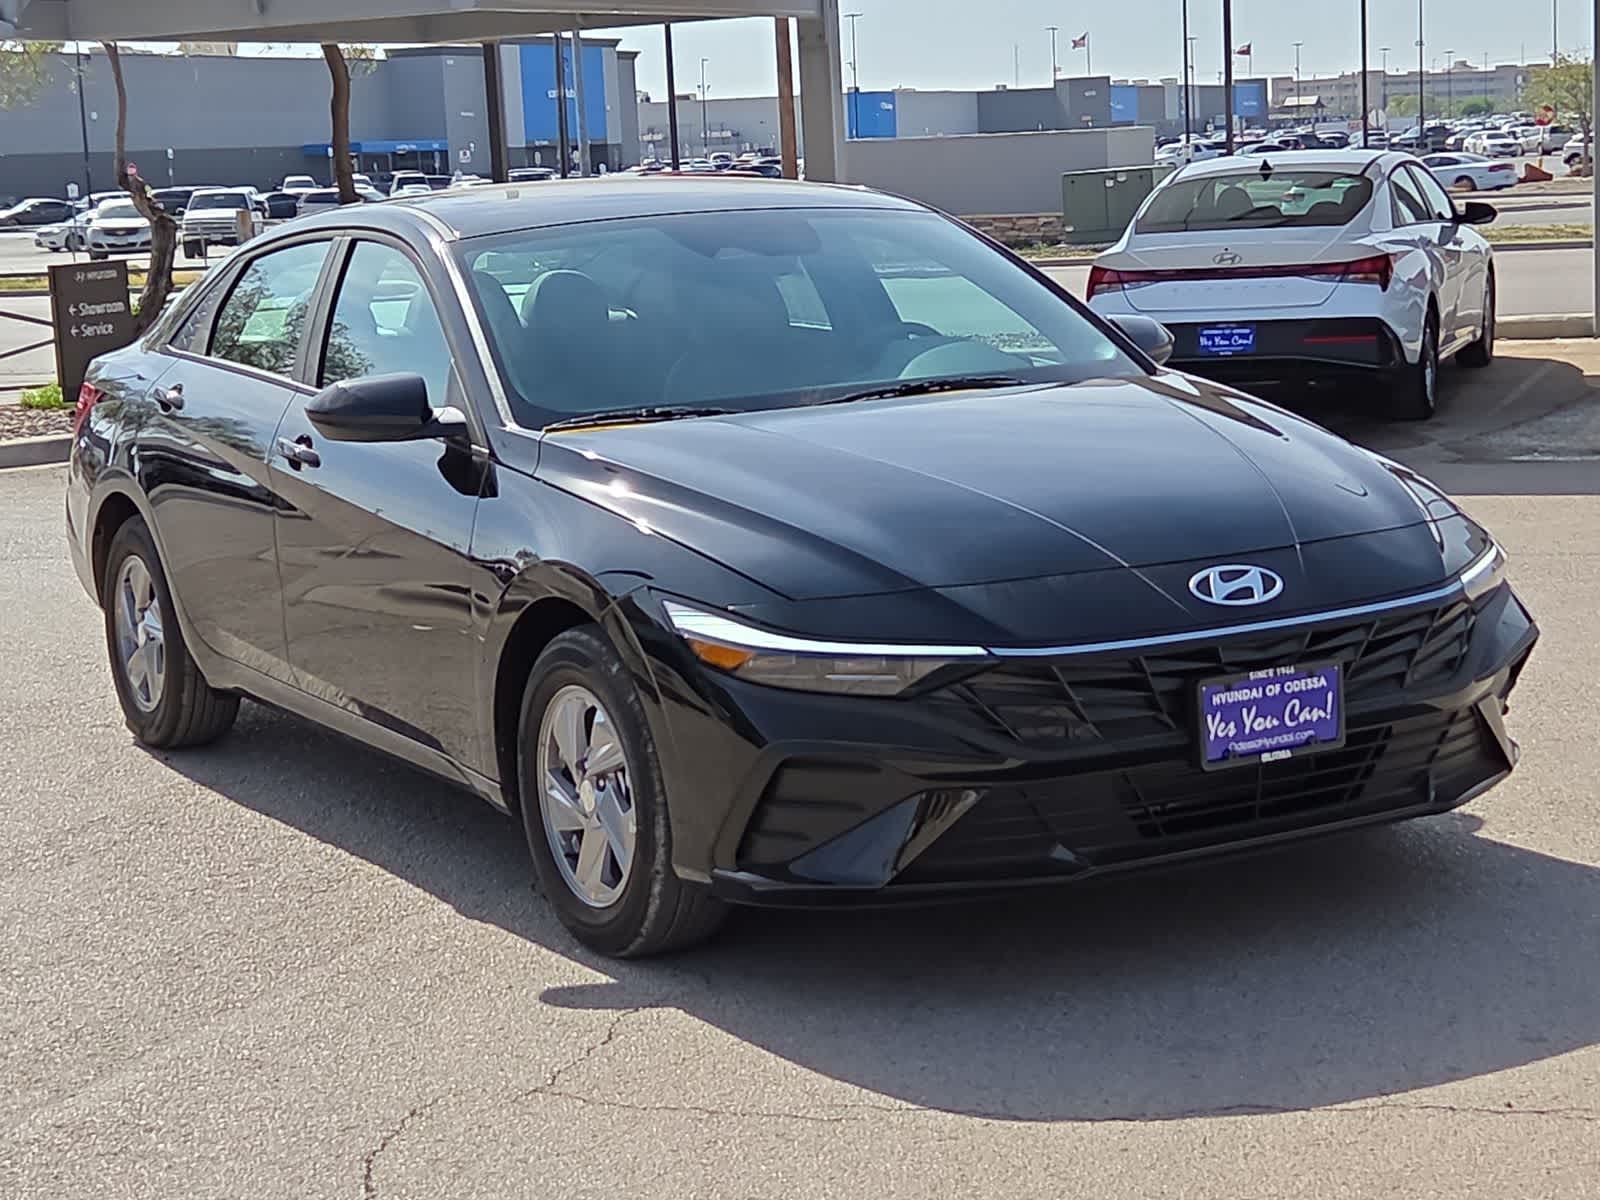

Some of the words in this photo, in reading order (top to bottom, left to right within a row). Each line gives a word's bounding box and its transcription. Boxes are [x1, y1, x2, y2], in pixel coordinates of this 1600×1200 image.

[79, 302, 125, 316] Showroom
[81, 321, 114, 336] Service
[1212, 686, 1263, 706] HYUNDAI
[1265, 683, 1281, 697] OF
[1283, 675, 1327, 694] ODESSA
[1206, 711, 1237, 742] Yes
[1241, 705, 1280, 735] You
[1284, 690, 1333, 727] Can!
